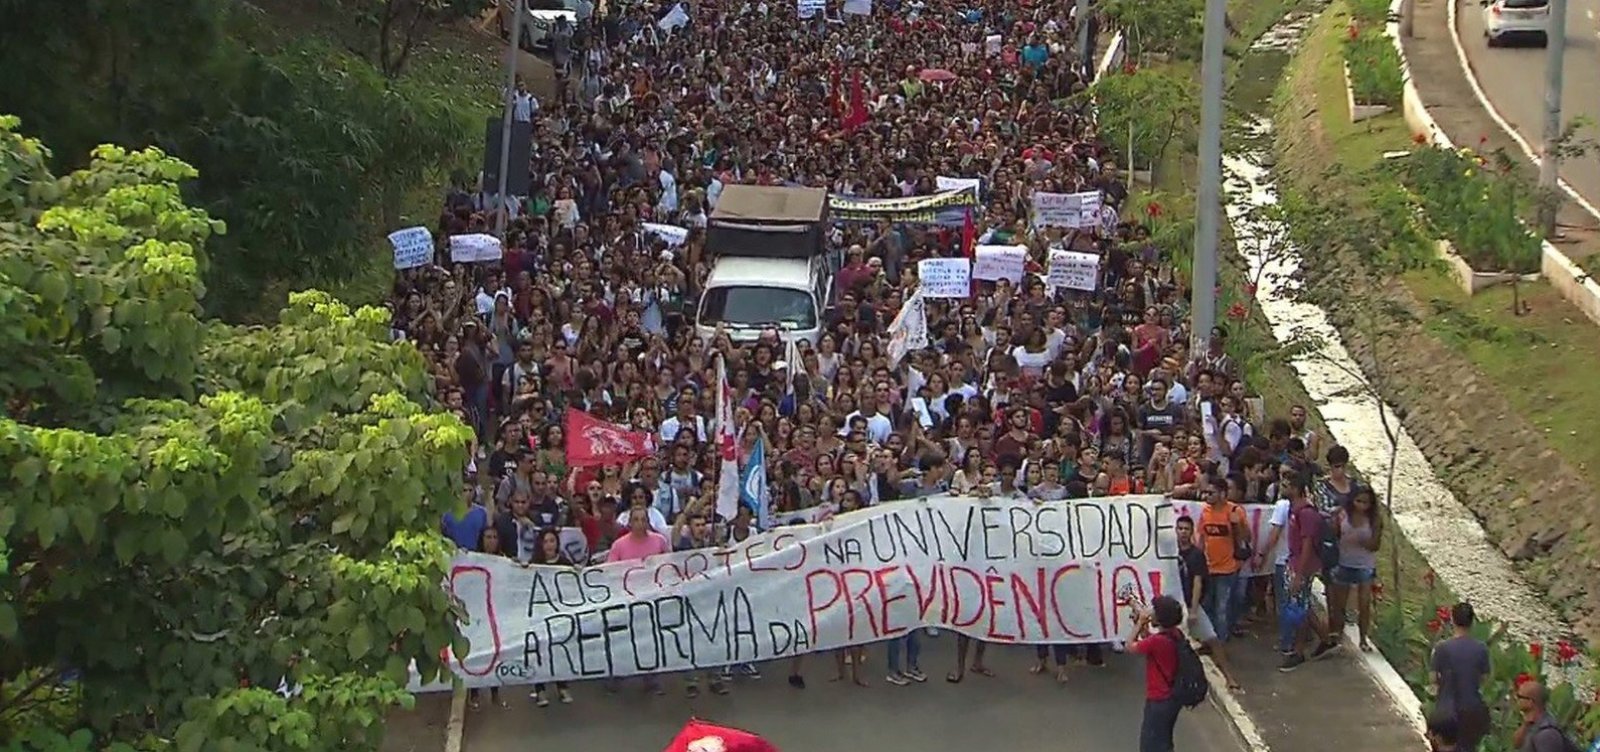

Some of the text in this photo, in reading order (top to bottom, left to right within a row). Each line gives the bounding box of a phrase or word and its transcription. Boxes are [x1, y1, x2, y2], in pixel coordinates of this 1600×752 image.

[528, 568, 611, 618] AOS
[623, 533, 807, 597] CORTES
[823, 537, 863, 564] NA
[868, 501, 1180, 563] UNIVERSIDADE
[523, 631, 542, 668] A
[543, 585, 759, 677] REFORMA
[769, 618, 810, 655] DA
